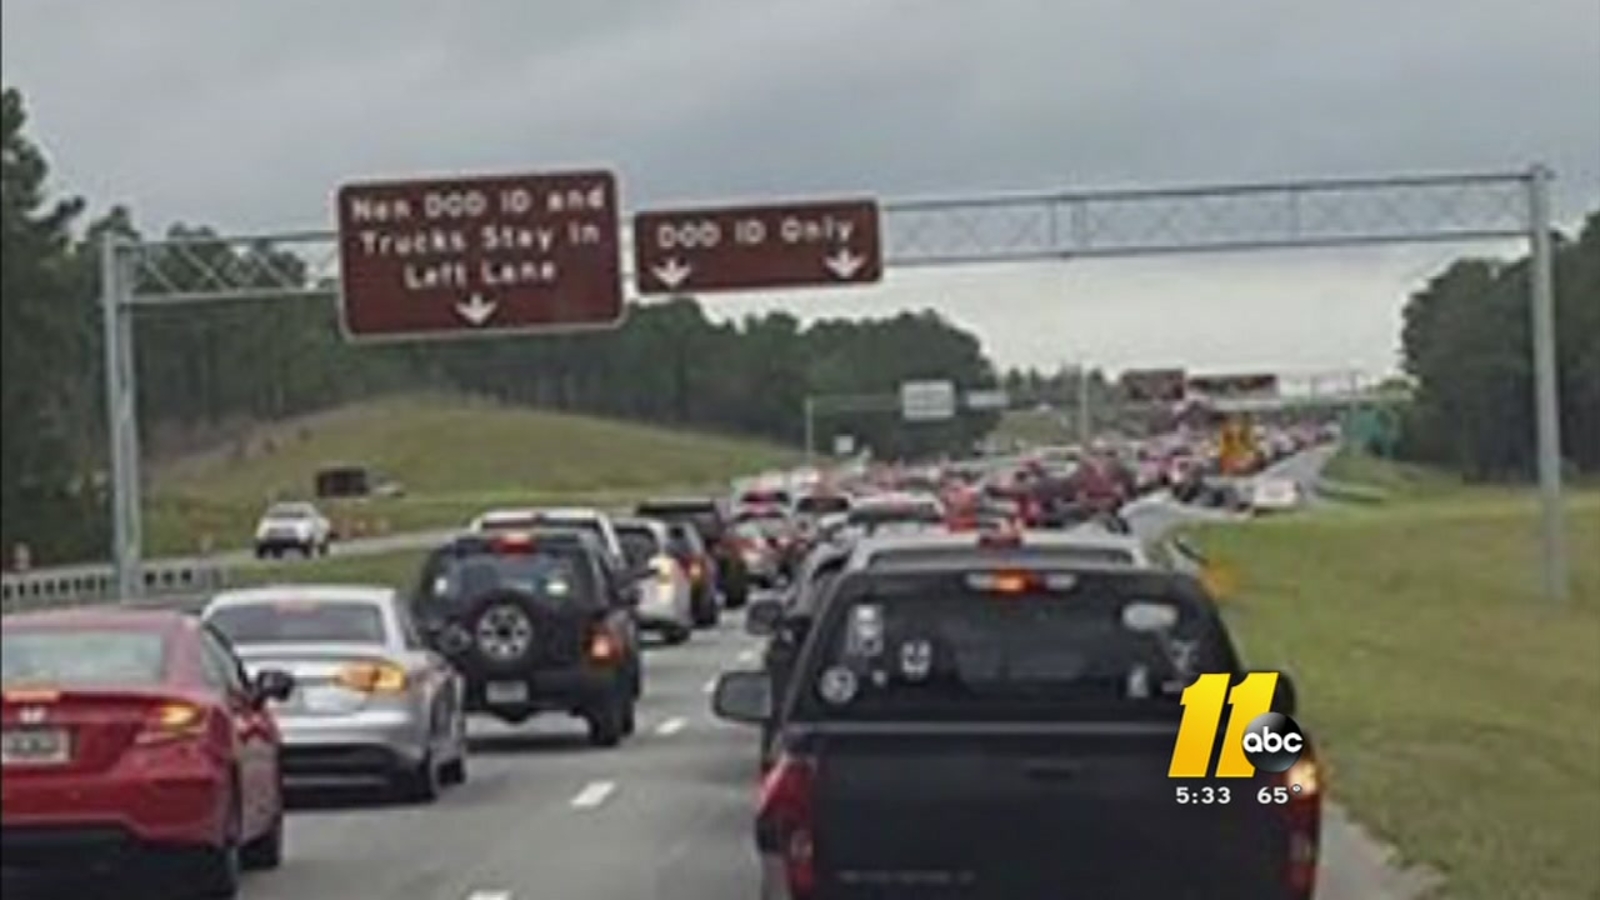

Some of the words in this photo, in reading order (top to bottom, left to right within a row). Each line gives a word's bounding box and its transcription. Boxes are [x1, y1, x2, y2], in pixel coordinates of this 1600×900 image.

[352, 197, 410, 221] Non
[424, 189, 488, 218] DOD
[501, 188, 532, 214] ID
[547, 183, 605, 212] and
[359, 225, 467, 255] Trucks
[481, 223, 554, 251] Stay
[657, 220, 722, 249] DOD
[734, 218, 767, 245] ID
[780, 214, 854, 243] Only
[403, 260, 467, 289] Left
[480, 259, 557, 285] Lane
